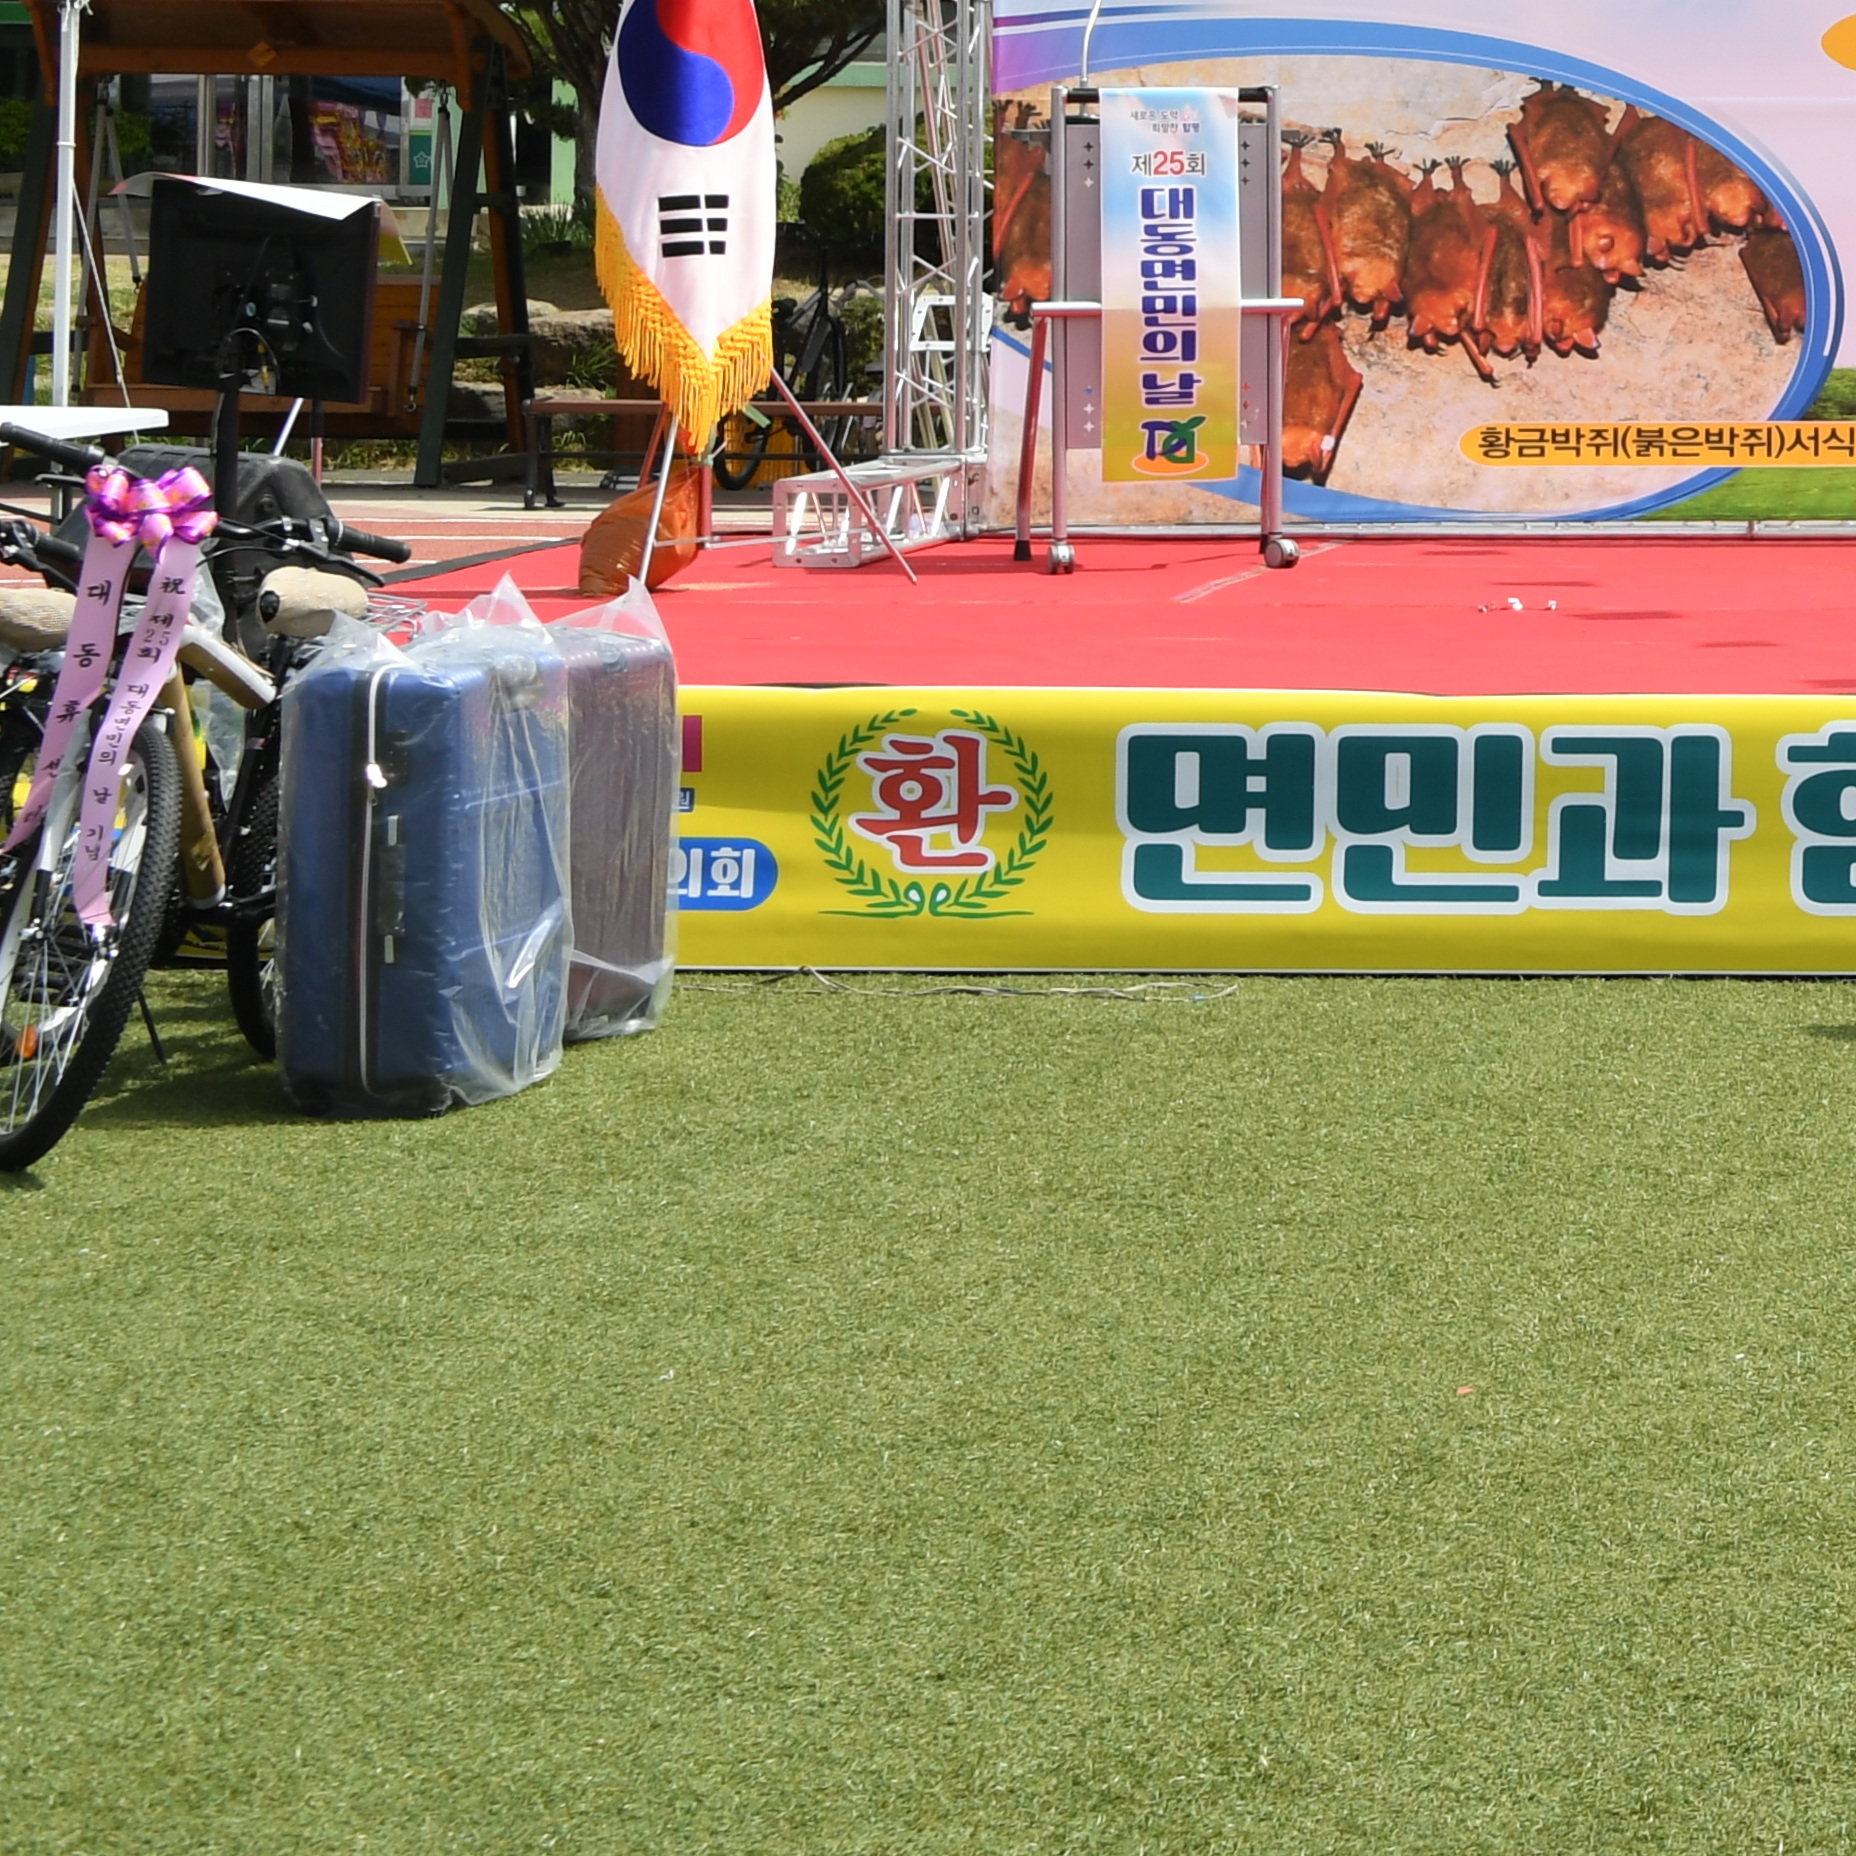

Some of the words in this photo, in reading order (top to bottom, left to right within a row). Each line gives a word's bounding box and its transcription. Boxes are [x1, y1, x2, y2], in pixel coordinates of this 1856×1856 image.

[1132, 150, 1205, 176] 제25회
[1139, 186, 1197, 362] 대동면민의
[1142, 373, 1203, 406] 날
[159, 577, 185, 595] 祝
[853, 733, 1014, 869] 환
[1126, 732, 1746, 905] 면민과
